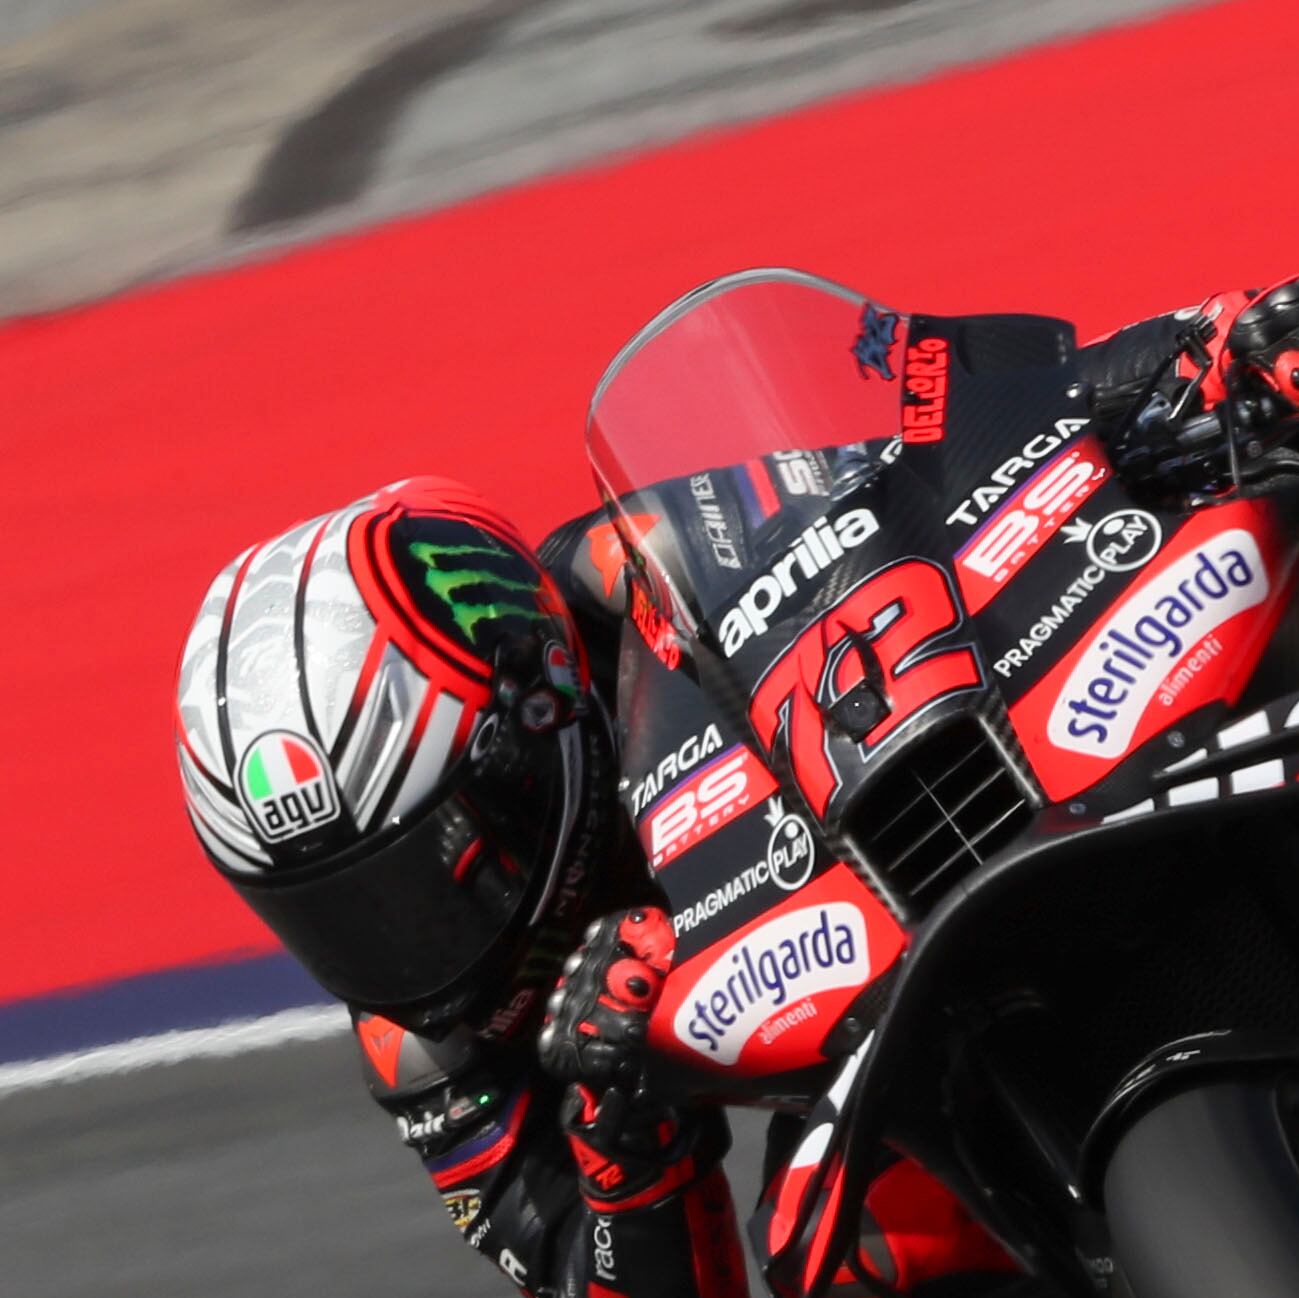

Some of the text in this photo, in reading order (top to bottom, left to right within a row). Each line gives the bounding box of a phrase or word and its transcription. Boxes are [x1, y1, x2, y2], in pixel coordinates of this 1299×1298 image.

[946, 417, 1091, 527] TARGA
[963, 458, 1097, 580] BS
[719, 508, 881, 659] aprilia
[994, 515, 1148, 680] PRAGMATIC PLAY
[748, 555, 990, 822] 72
[1068, 542, 1253, 744] sterilgarda
[1159, 634, 1223, 707] alimenti
[263, 781, 325, 830] agv
[631, 723, 724, 817] TARGA
[651, 757, 748, 856] BS
[673, 832, 810, 938] PRAGMATIC PLAY
[687, 909, 857, 1052] sterilgarda
[758, 997, 818, 1045] alimenti
